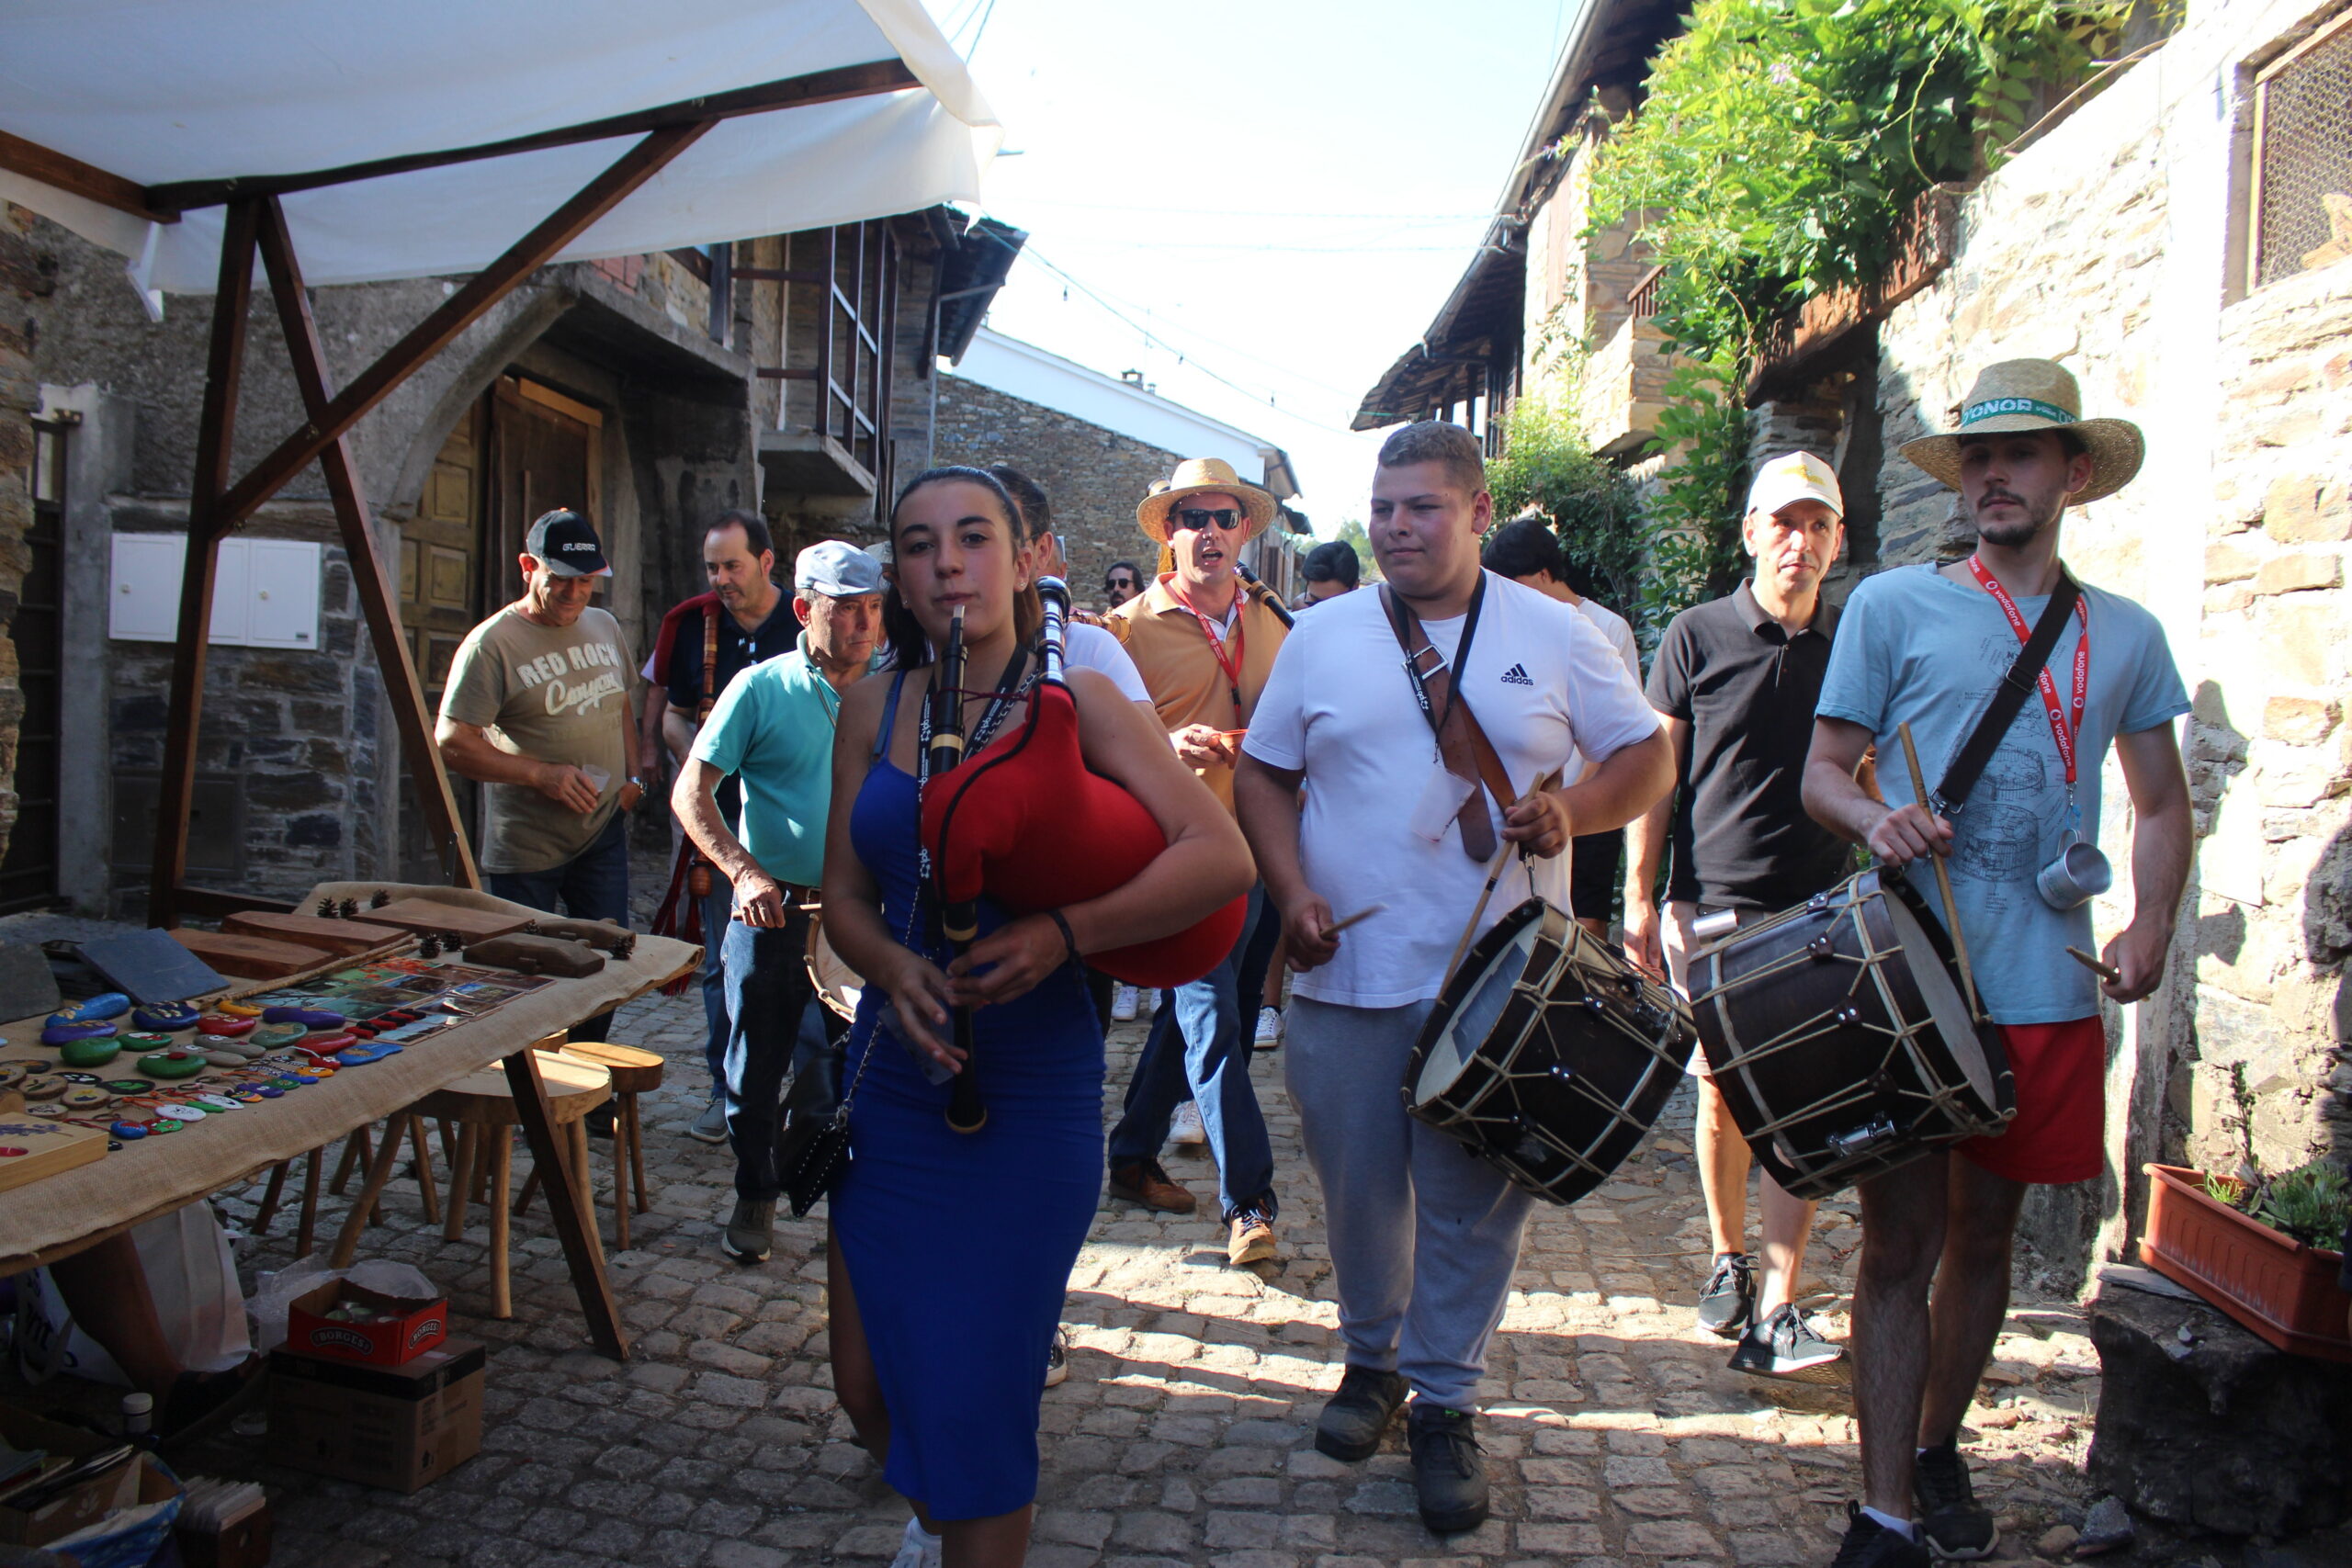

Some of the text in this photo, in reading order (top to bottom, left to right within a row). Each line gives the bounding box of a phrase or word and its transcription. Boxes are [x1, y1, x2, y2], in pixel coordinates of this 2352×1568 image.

[1995, 591, 2020, 626] vodafone
[516, 643, 620, 689] RED ROCK
[1500, 675, 1533, 686] adidas
[2075, 650, 2086, 694] vodafone
[545, 671, 626, 716] Canyon
[2054, 723, 2072, 768] vodafone
[319, 1329, 366, 1348] BORGES
[413, 1321, 438, 1342] BORGES
